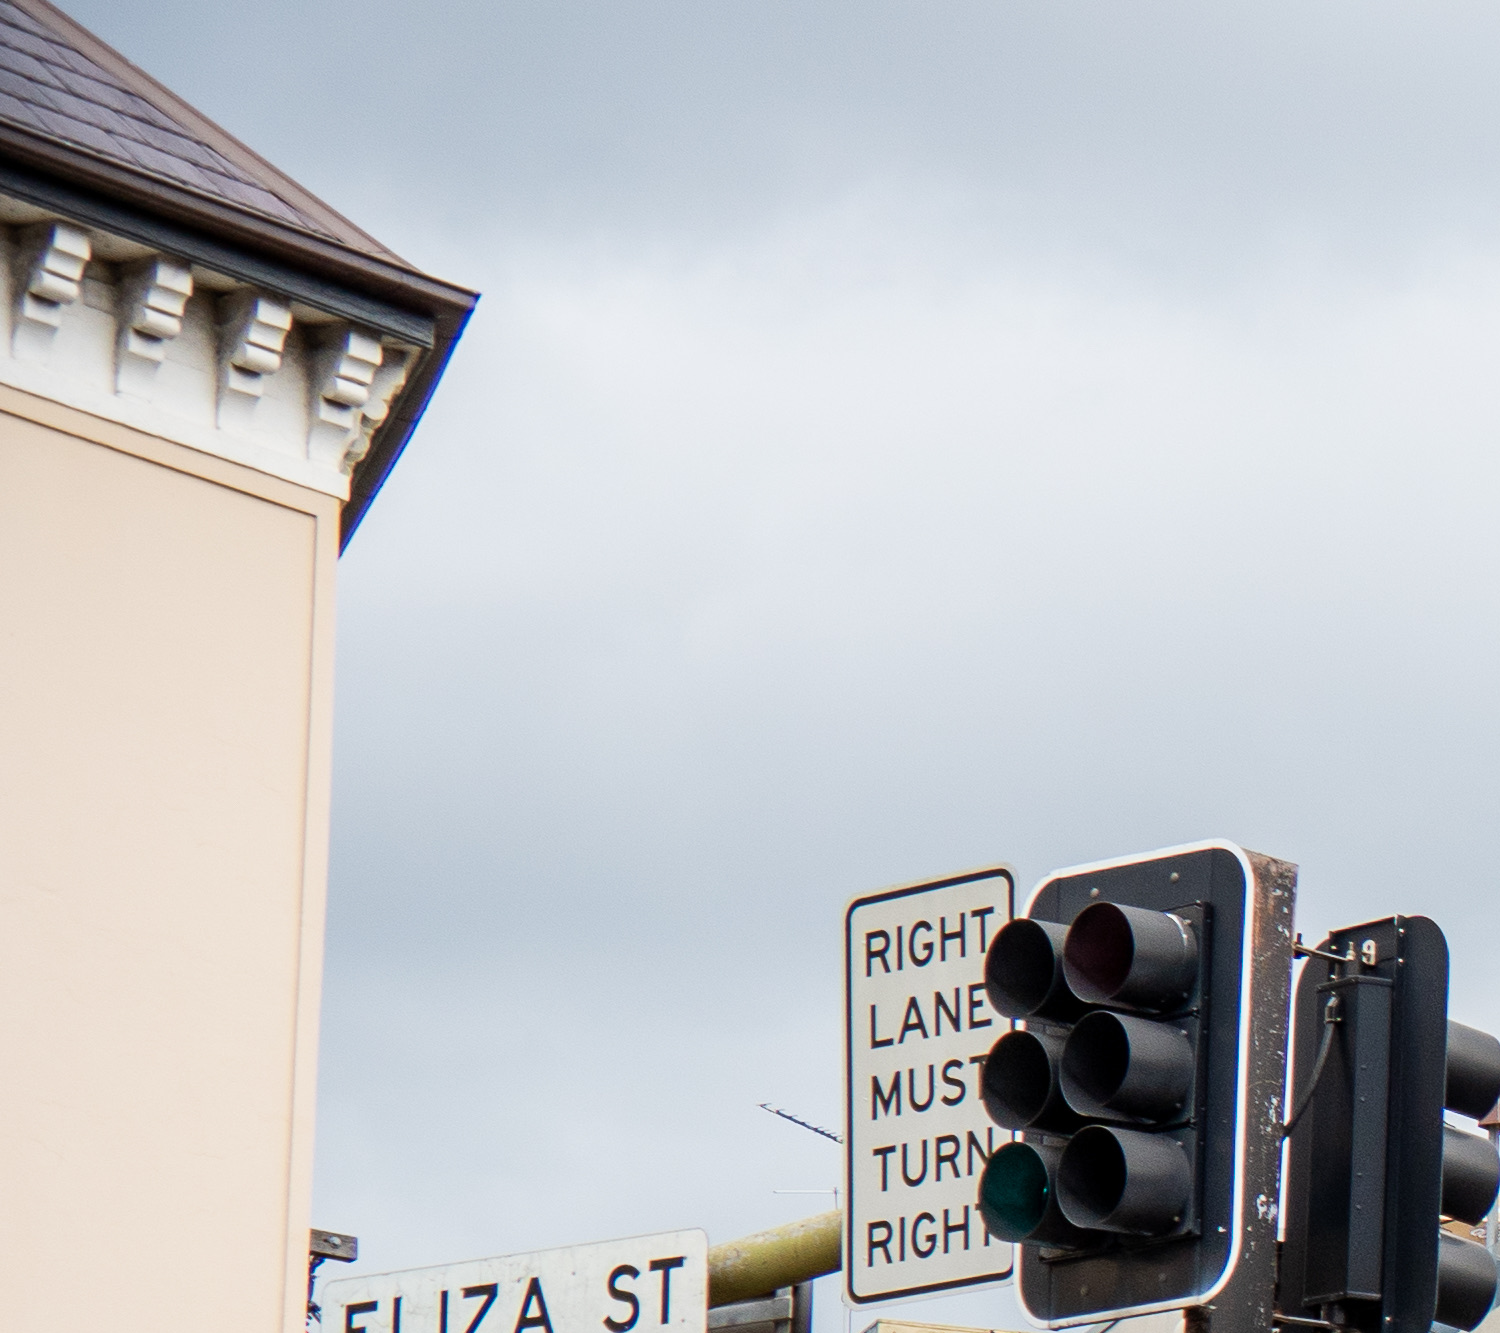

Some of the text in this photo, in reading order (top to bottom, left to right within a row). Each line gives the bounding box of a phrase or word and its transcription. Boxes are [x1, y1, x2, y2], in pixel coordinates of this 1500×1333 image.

[864, 906, 995, 977] RIGHT
[868, 983, 993, 1049] LANE
[872, 1125, 994, 1191] TURN
[602, 1256, 686, 1333] ST
